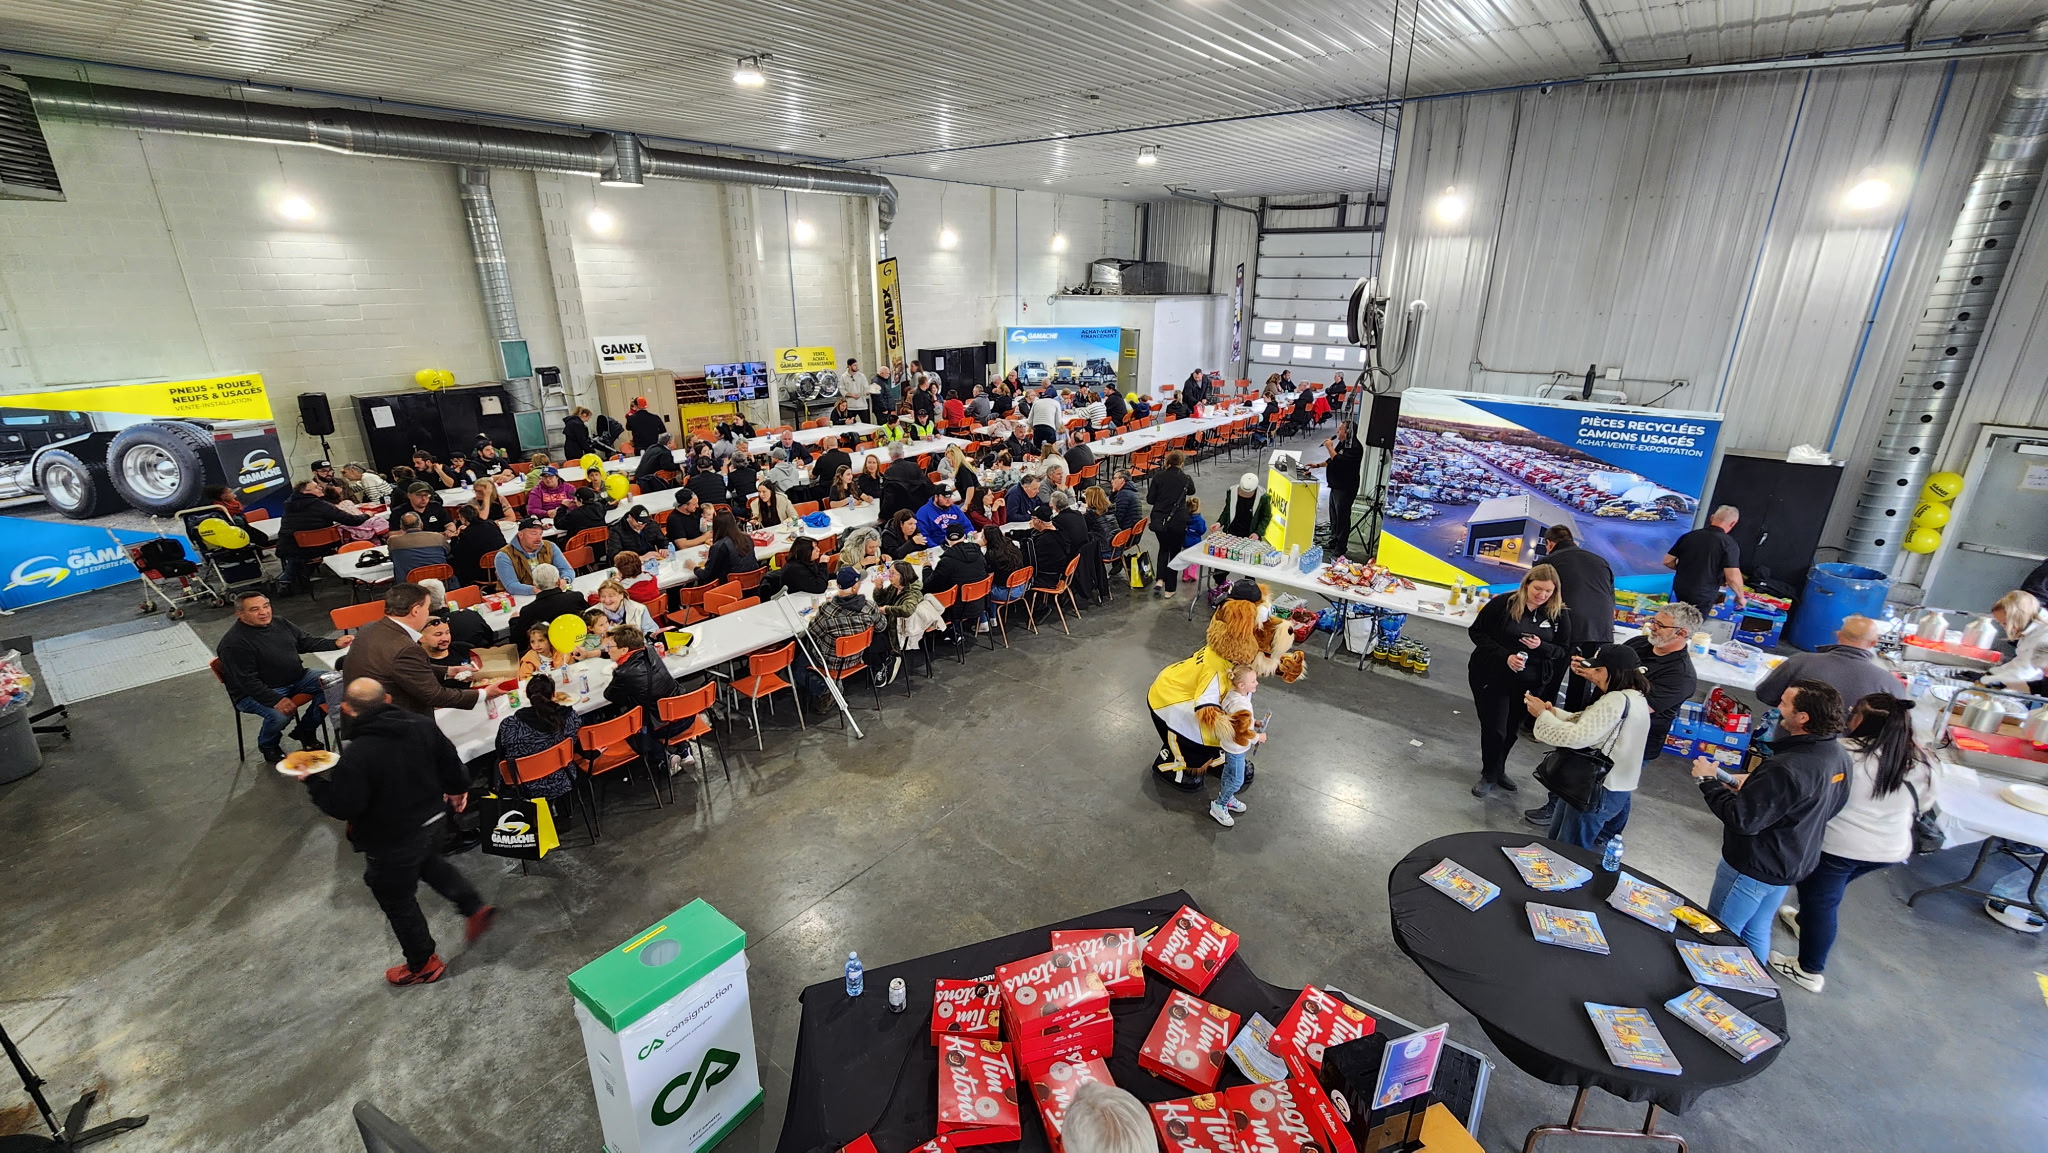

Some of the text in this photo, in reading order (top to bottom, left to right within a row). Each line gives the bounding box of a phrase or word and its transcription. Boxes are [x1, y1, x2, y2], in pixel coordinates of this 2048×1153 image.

[882, 285, 897, 349] GAMEX
[601, 343, 644, 354] GAMEX
[169, 385, 207, 395] PNEUS
[216, 380, 253, 390] ROUES
[172, 386, 262, 404] NEUFS & USAGÉS
[175, 397, 253, 411] VENTE-INSTALLATION
[1580, 416, 1706, 436] PIÈCES RECYCLÉES
[1578, 428, 1695, 447] CAMIONS USAGÉS
[1576, 438, 1704, 457] ACHAT-VENTE-EXPORTATION
[238, 466, 282, 485] GAMACHE
[67, 546, 127, 569] GAMA
[76, 567, 88, 576] LES
[90, 561, 119, 573] EXPERTS
[491, 833, 536, 845] GAMACHE
[1193, 931, 1227, 960] Tim
[1043, 977, 1093, 1008] Tim
[666, 983, 733, 1037] consignaction
[956, 1008, 989, 1032] Tim
[1196, 1017, 1229, 1053] Tim
[980, 1053, 1014, 1093] Tim
